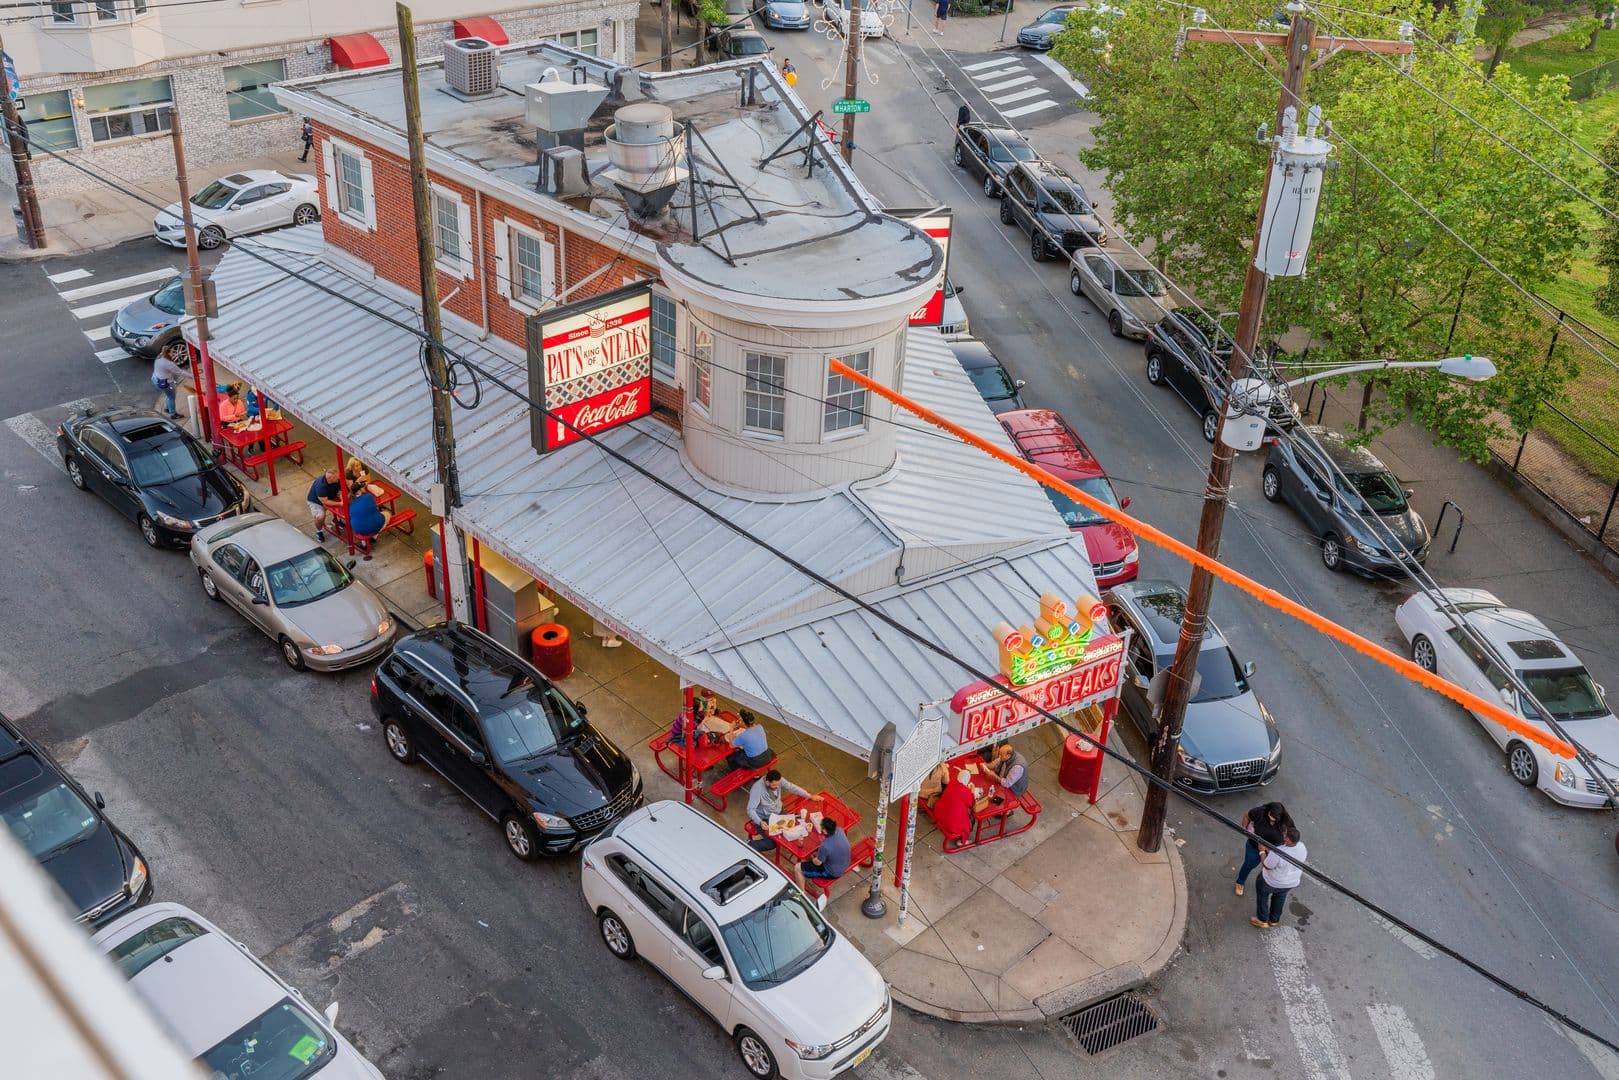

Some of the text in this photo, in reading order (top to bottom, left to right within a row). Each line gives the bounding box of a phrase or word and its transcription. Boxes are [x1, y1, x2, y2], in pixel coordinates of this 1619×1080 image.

[547, 324, 648, 384] PAT'S KING OF STEAKS
[568, 329, 589, 340] Since
[573, 386, 641, 431] Coca-Cola
[967, 698, 1018, 740] PAT'S
[1043, 659, 1120, 709] STEAKS
